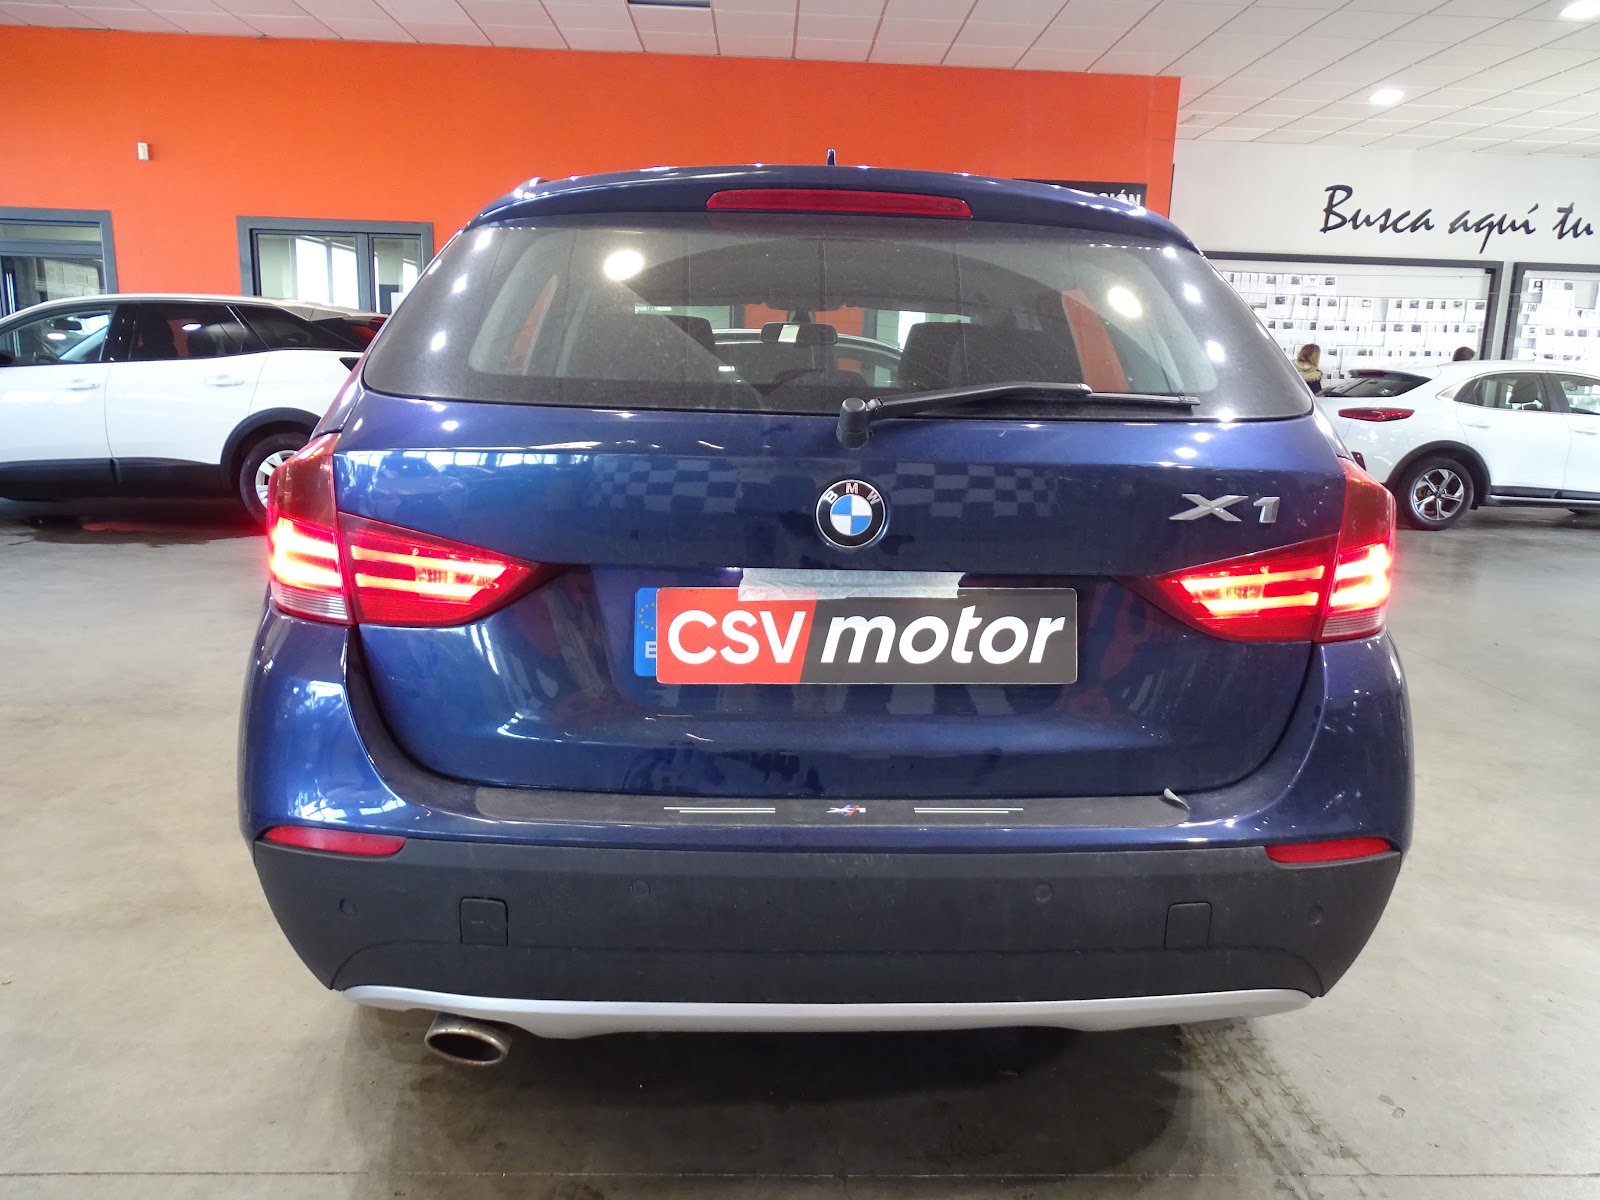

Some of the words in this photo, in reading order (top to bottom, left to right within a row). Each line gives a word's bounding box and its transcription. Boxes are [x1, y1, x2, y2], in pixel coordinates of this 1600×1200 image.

[1319, 184, 1435, 234] Busca
[1448, 203, 1539, 254] aquí
[1552, 202, 1594, 240] tu
[822, 482, 881, 506] BMW
[1168, 493, 1281, 523] X1
[667, 609, 807, 665] CSV
[820, 604, 1066, 665] motor
